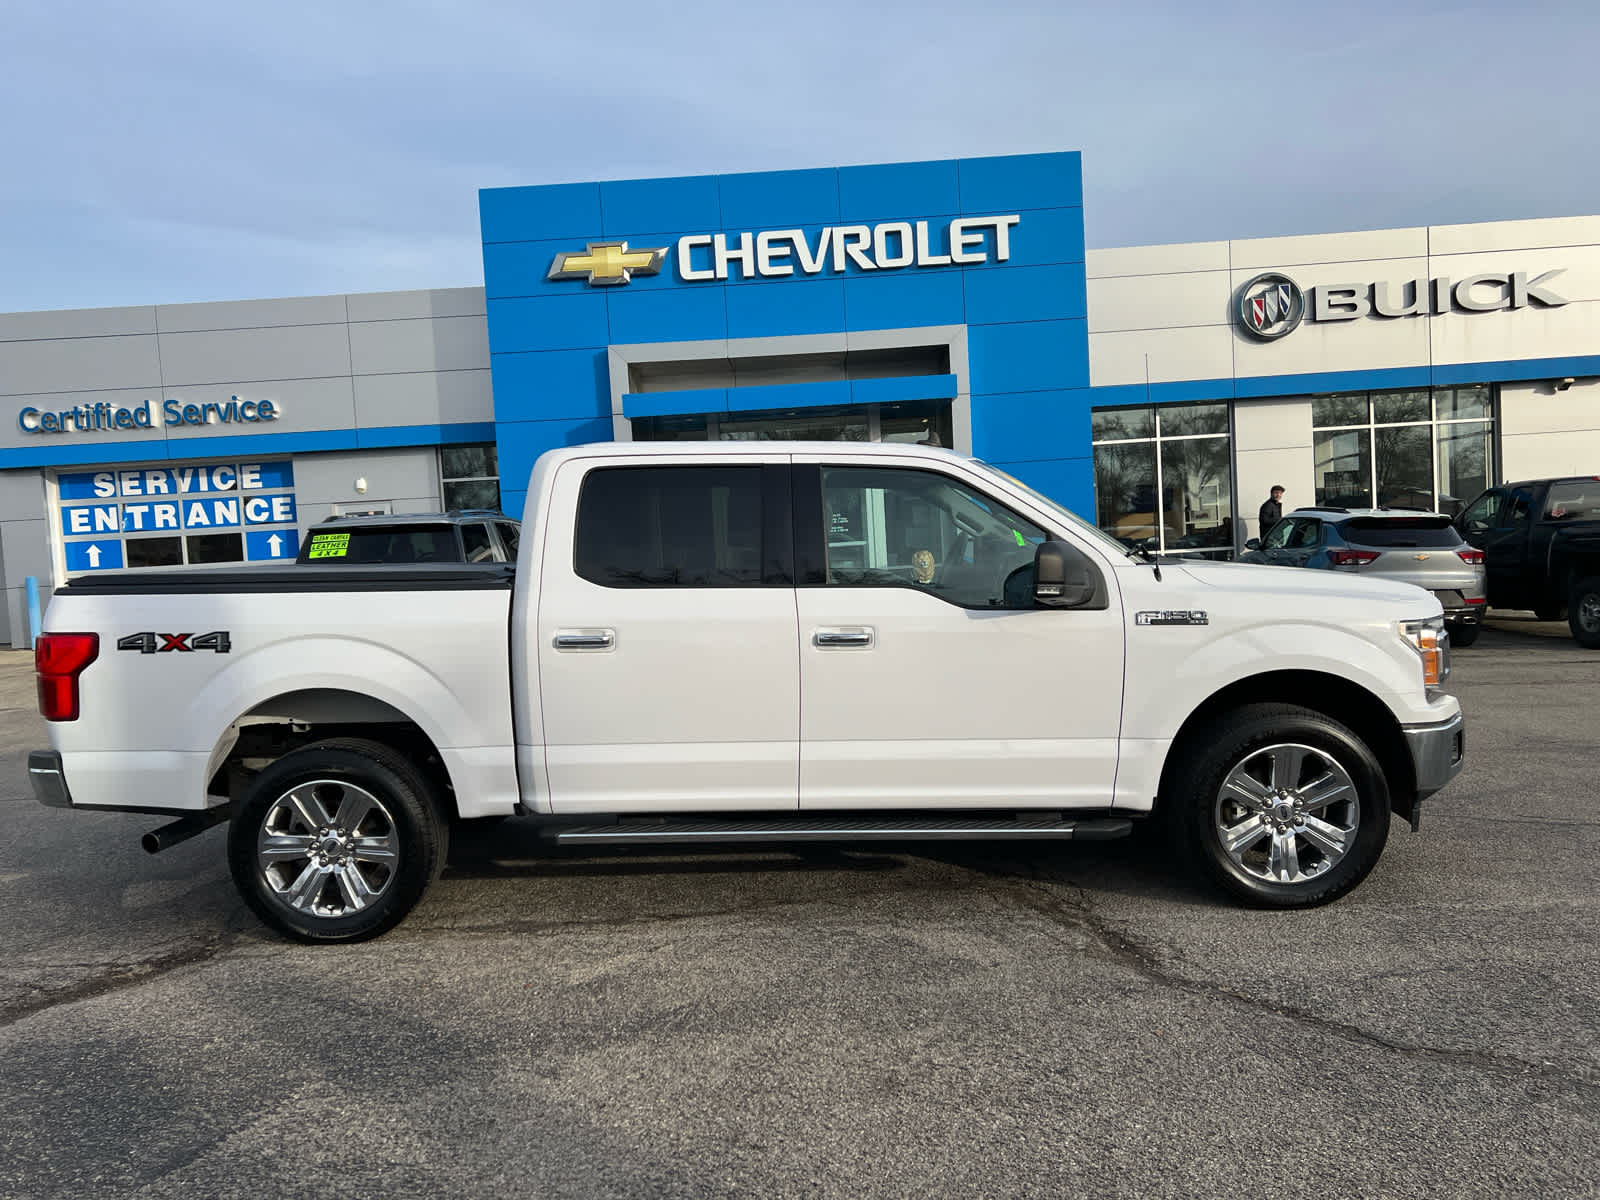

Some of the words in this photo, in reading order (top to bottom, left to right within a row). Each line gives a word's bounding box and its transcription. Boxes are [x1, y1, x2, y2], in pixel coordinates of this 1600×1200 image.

[678, 214, 1021, 282] CHEVROLET
[1315, 268, 1570, 322] BUICK
[18, 399, 152, 433] Certified
[163, 395, 275, 426] Service
[93, 465, 264, 498] SERVICE
[70, 497, 294, 533] ENTRANCE
[311, 541, 348, 550] LEATHER
